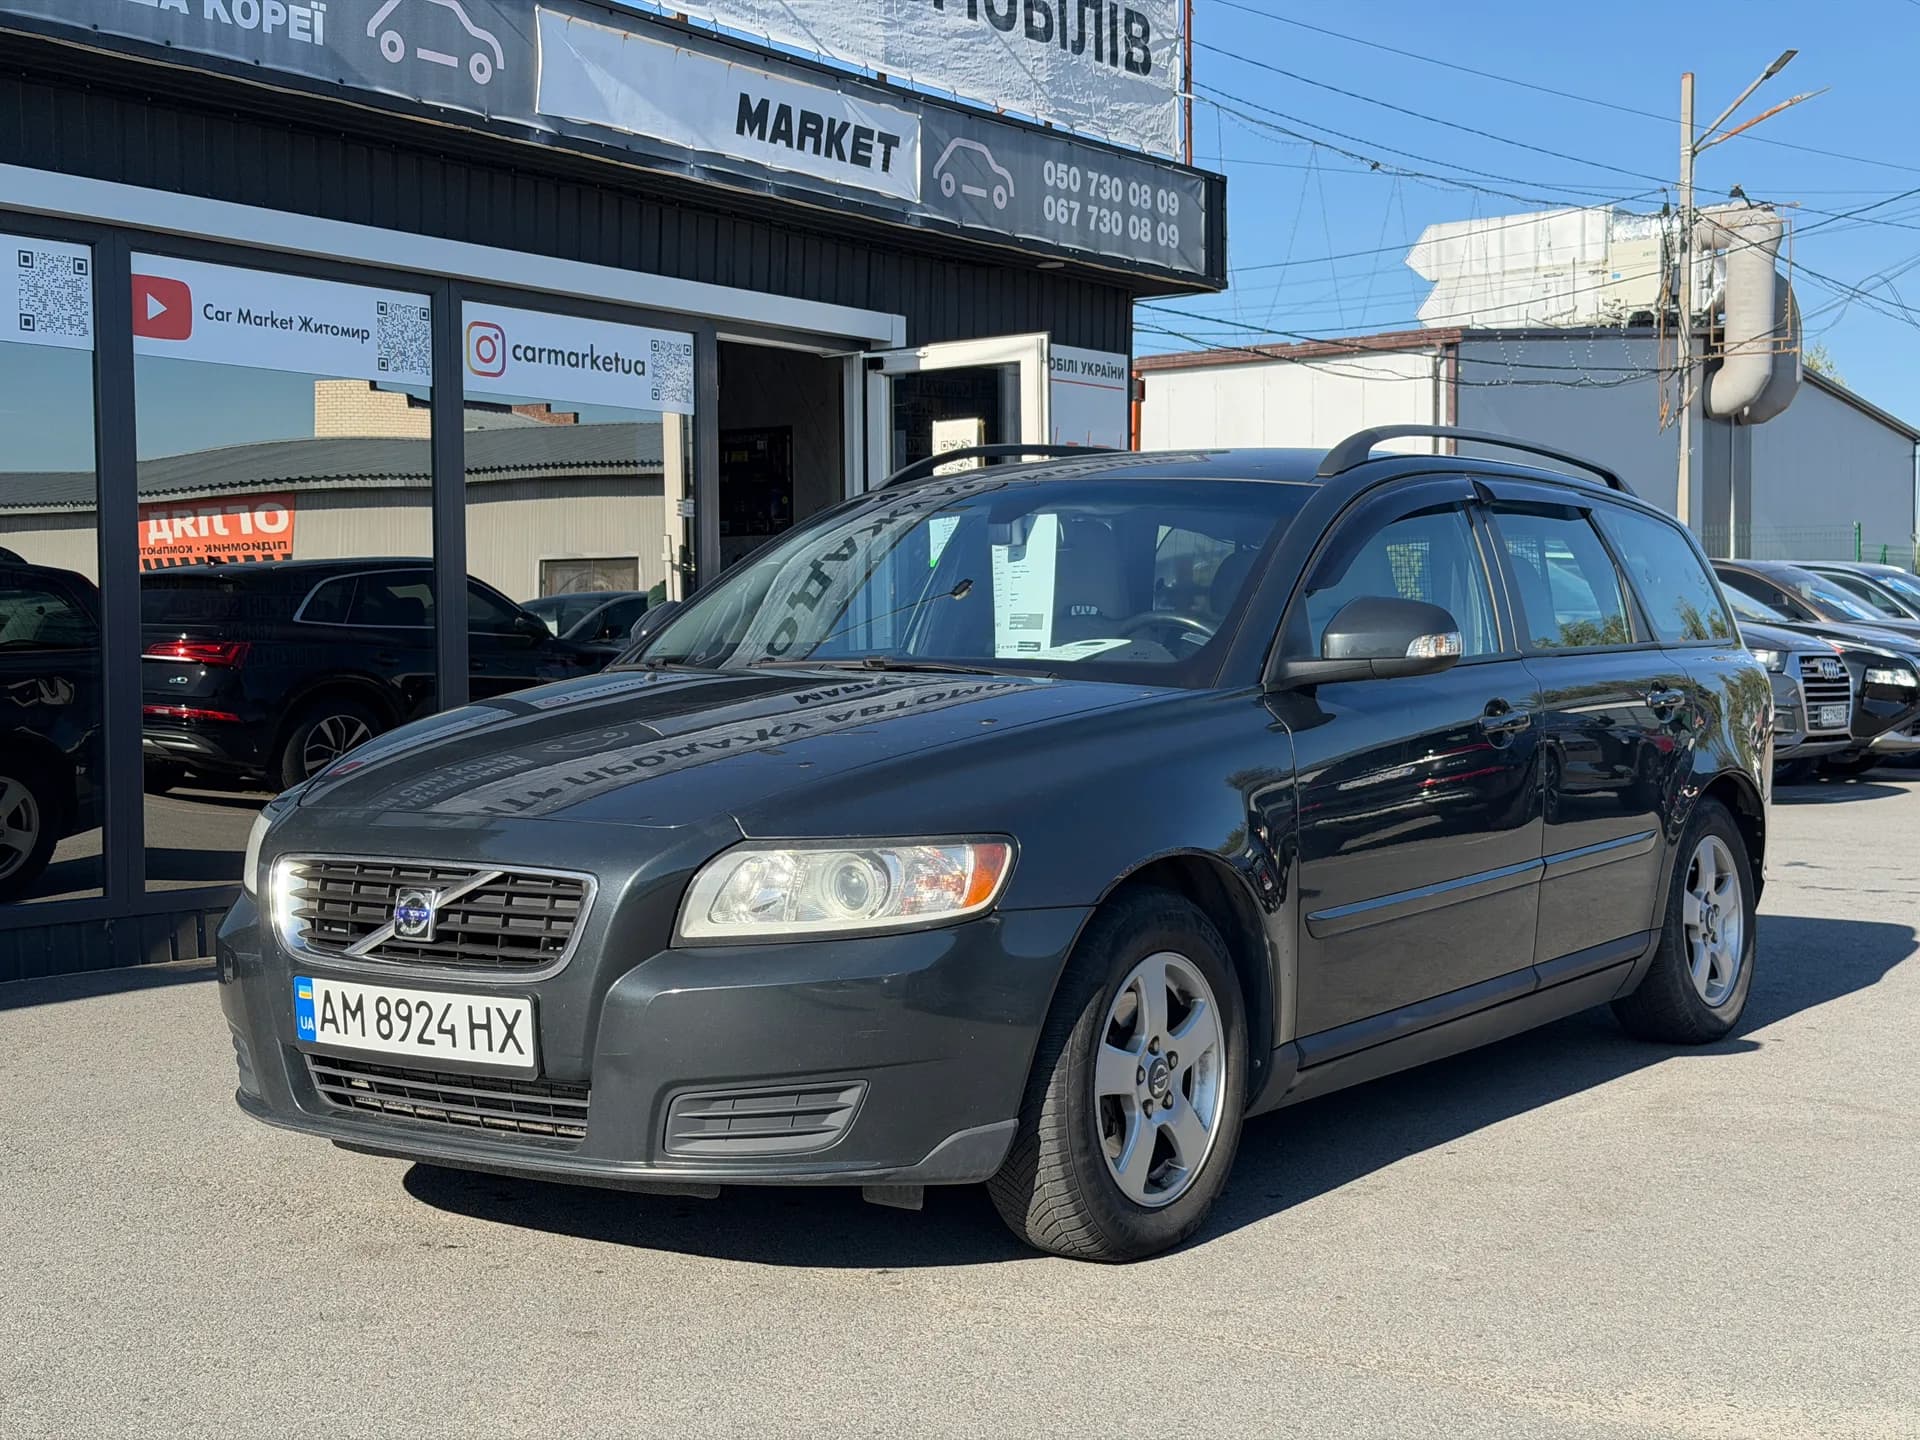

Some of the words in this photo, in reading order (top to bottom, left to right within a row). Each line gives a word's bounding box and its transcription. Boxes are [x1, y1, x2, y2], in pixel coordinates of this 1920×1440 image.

[203, 0, 326, 46] КОРЕЇ
[735, 91, 900, 173] MARKET
[1043, 160, 1081, 192] 050
[1087, 171, 1123, 203] 730
[1128, 181, 1151, 210] 08
[1157, 188, 1180, 217] 09
[1043, 195, 1081, 226] 067
[1087, 205, 1123, 236] 730
[1128, 214, 1151, 243] 08
[1157, 222, 1180, 249] 09
[203, 303, 232, 323] Car
[237, 307, 294, 332] Market
[298, 315, 371, 345] Житомир
[512, 343, 646, 377] carmarketua
[1081, 360, 1125, 381] УКРАЇНИ
[300, 1015, 315, 1032] UA
[320, 989, 366, 1038] AM
[375, 996, 457, 1049] 8924
[467, 1005, 525, 1056] HX
